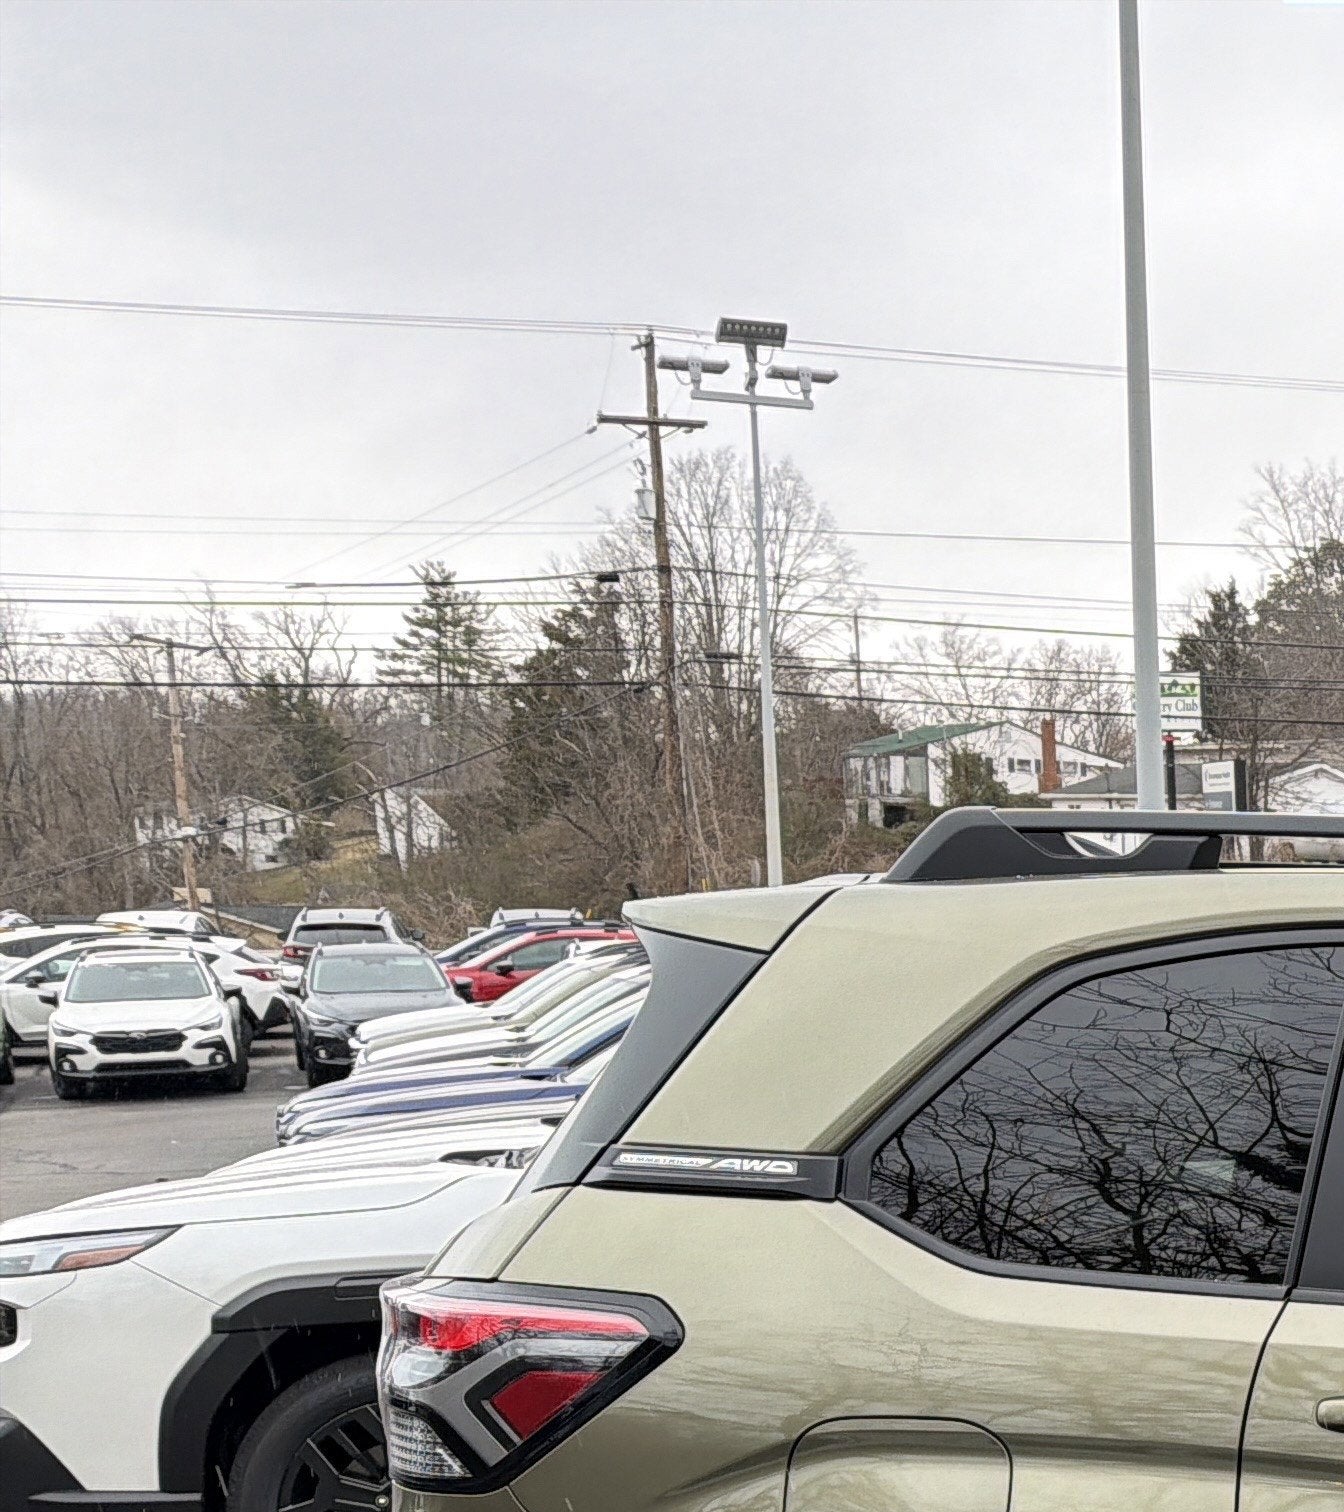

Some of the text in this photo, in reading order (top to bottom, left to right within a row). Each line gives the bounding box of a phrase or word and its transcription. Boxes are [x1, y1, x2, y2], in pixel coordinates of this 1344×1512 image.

[1174, 698, 1199, 712] Club
[621, 1155, 795, 1174] SYMMETRICAL AWD
